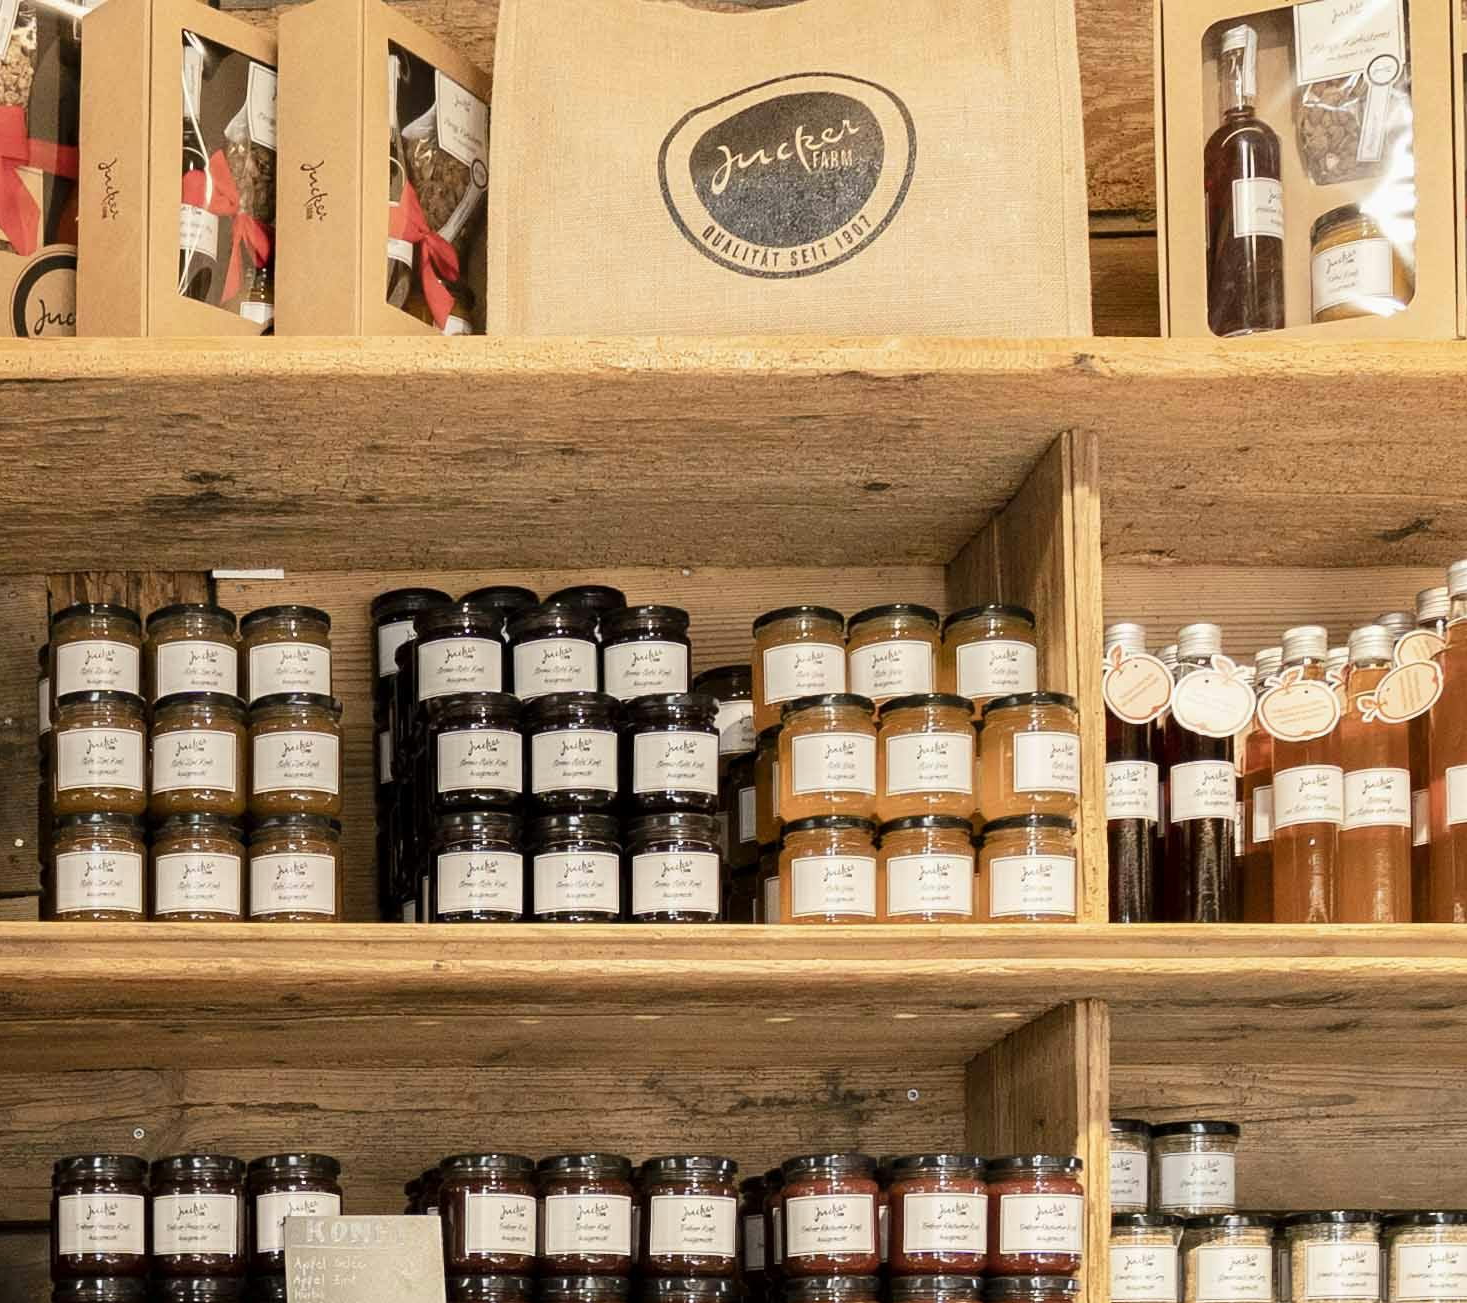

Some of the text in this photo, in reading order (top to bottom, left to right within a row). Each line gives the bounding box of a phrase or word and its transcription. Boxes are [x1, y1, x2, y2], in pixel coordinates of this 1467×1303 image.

[711, 119, 860, 194] Jucker
[812, 150, 853, 168] FARM
[701, 225, 780, 267] QUALITÄT
[790, 243, 828, 266] SEIT
